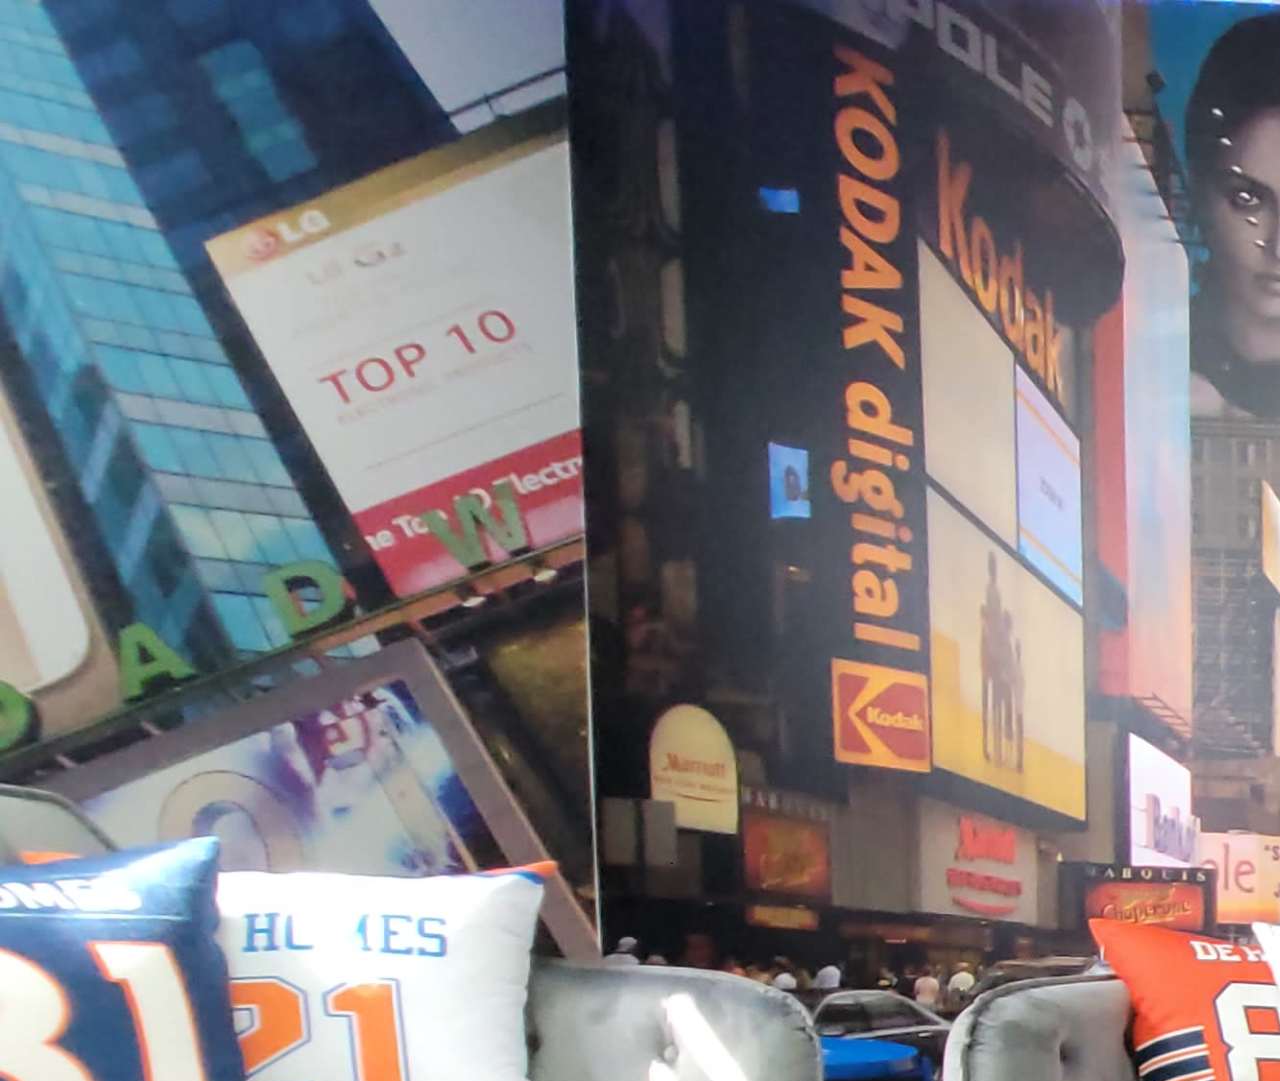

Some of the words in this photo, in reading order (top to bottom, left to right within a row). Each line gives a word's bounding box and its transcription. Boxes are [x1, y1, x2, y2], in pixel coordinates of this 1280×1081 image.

[832, 43, 906, 370] KODAK
[317, 343, 427, 405] TOP
[445, 310, 516, 354] 10
[830, 381, 921, 652] digital
[866, 705, 925, 732] Kodak
[242, 912, 449, 958] HES
[1189, 940, 1241, 963] DE
